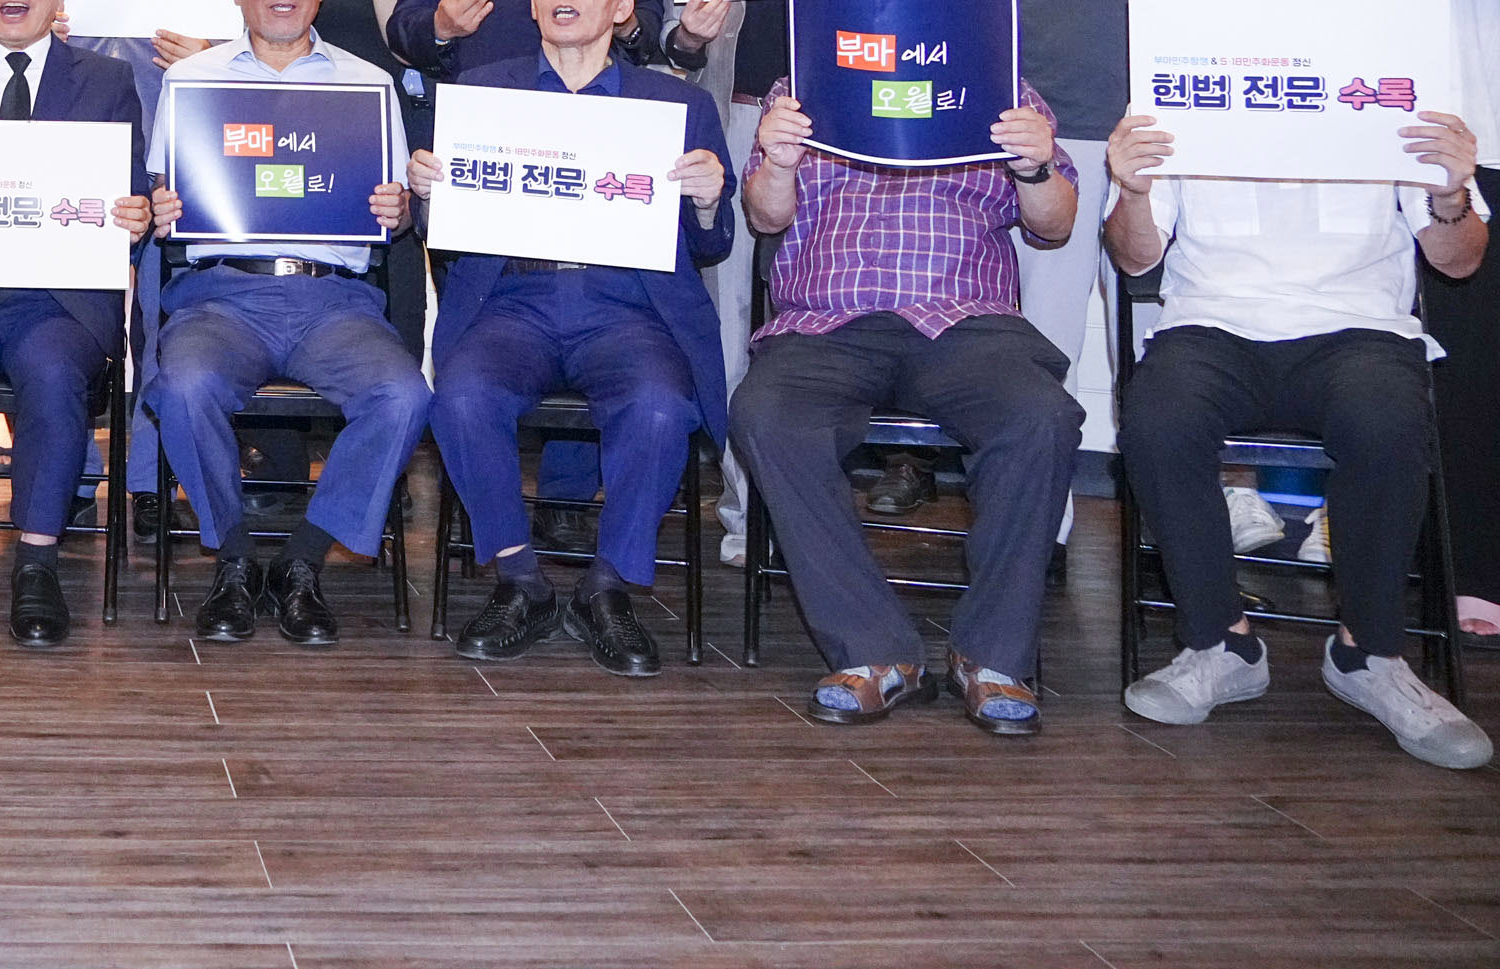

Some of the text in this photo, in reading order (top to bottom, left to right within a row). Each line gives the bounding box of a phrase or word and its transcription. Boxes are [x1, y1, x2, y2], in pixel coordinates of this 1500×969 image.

[1292, 57, 1312, 67] 정신
[1151, 73, 1417, 112] 헌법 전문 수록
[561, 151, 577, 160] 정신
[450, 157, 654, 204] 헌법 전문 수록
[50, 197, 106, 227] 수록
